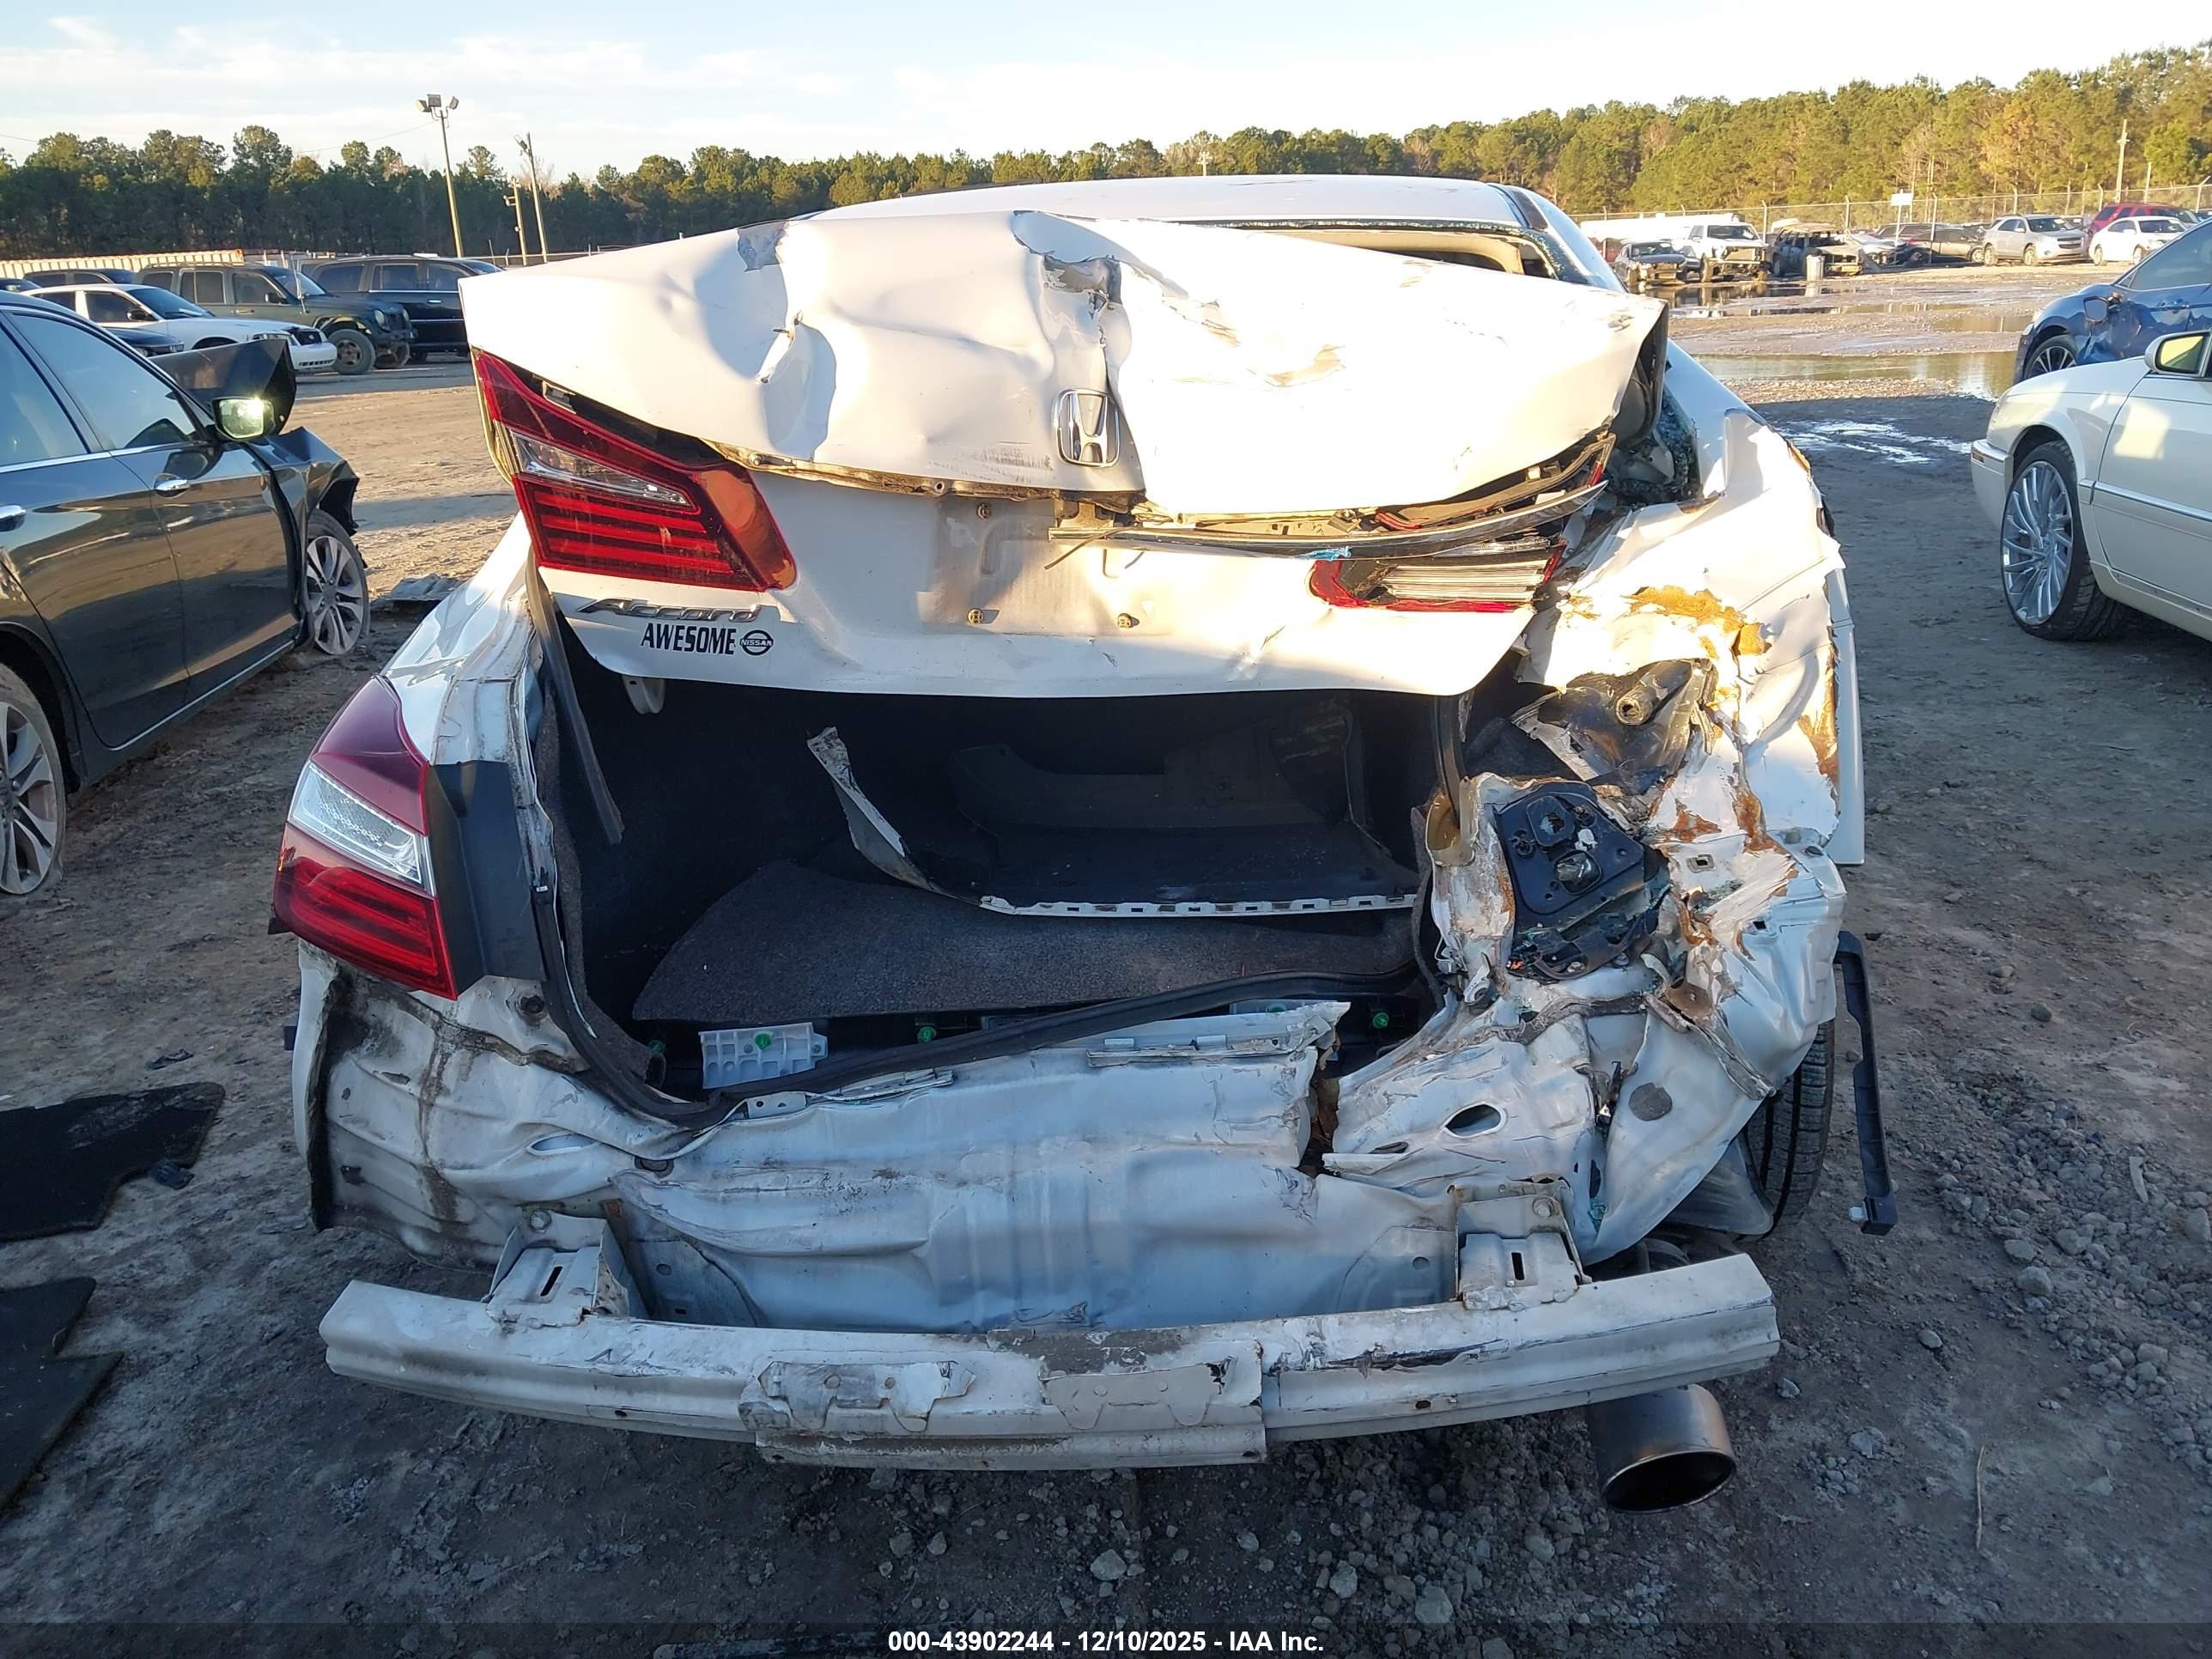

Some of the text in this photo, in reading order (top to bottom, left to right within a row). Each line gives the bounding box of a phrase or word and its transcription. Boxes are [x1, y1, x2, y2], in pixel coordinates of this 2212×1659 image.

[577, 598, 763, 623] Accord
[641, 623, 738, 655] AWESOME
[739, 638, 775, 647] NISSAN
